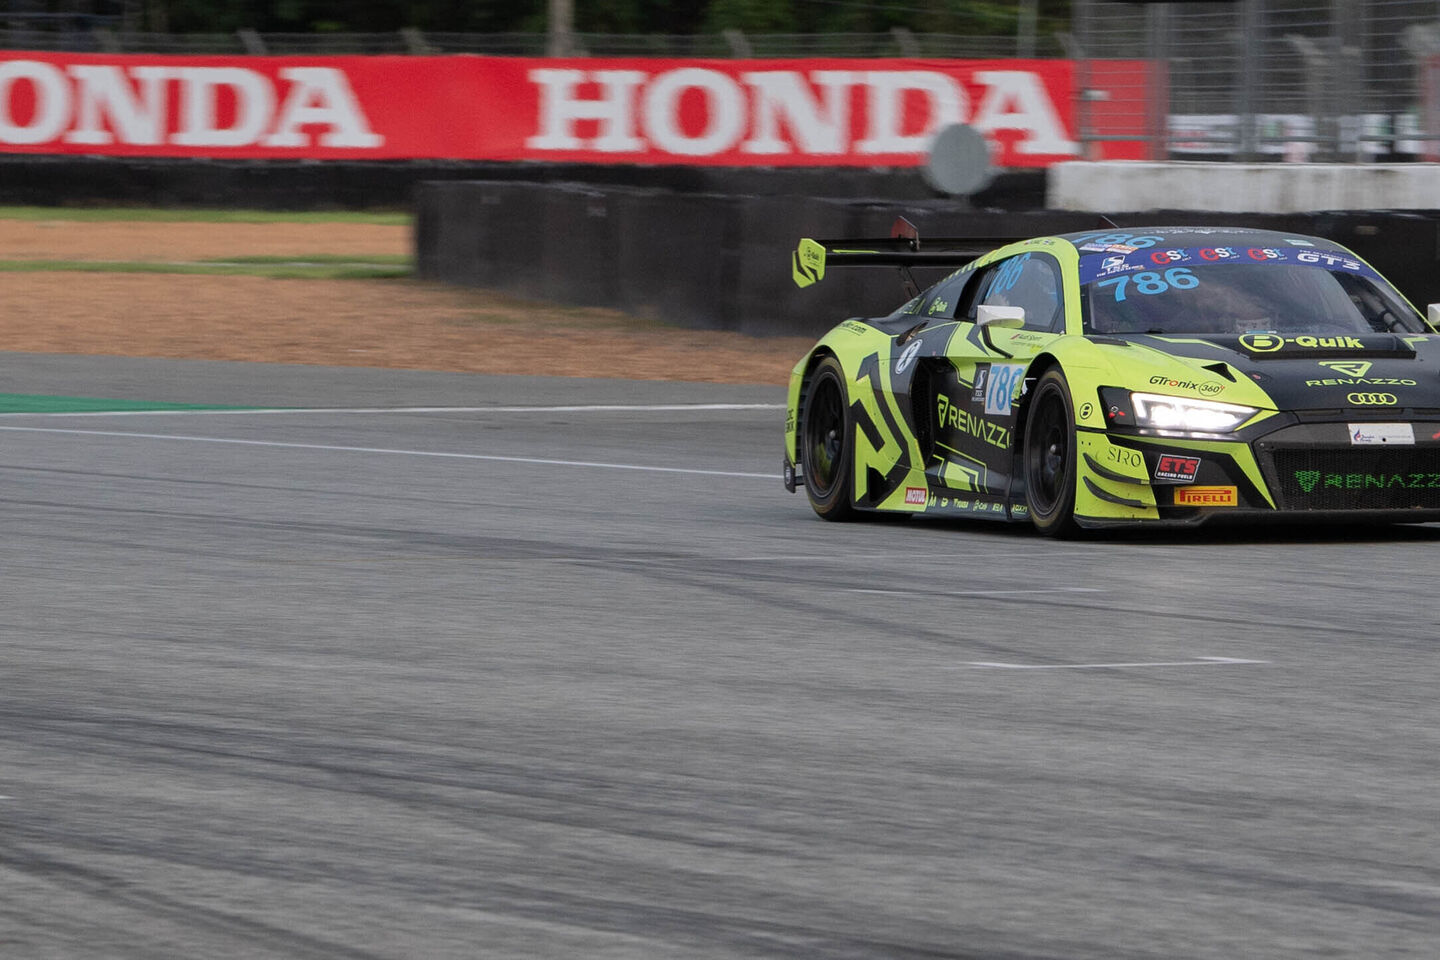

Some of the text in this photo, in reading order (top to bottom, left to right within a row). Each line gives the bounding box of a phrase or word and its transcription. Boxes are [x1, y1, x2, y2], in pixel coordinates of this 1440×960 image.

[0, 60, 385, 148] ONDA
[526, 66, 1080, 157] HONDA
[1070, 233, 1165, 249] 786
[1297, 253, 1361, 270] GT3
[985, 252, 1031, 299] 786
[1097, 267, 1200, 303] 786
[1239, 333, 1365, 352] B-Quik
[1149, 375, 1199, 390] GTronix
[1305, 378, 1417, 387] RENAZZO
[1107, 447, 1142, 468] SIRO
[1159, 456, 1198, 474] ETS
[1180, 490, 1232, 503] PIRELLI
